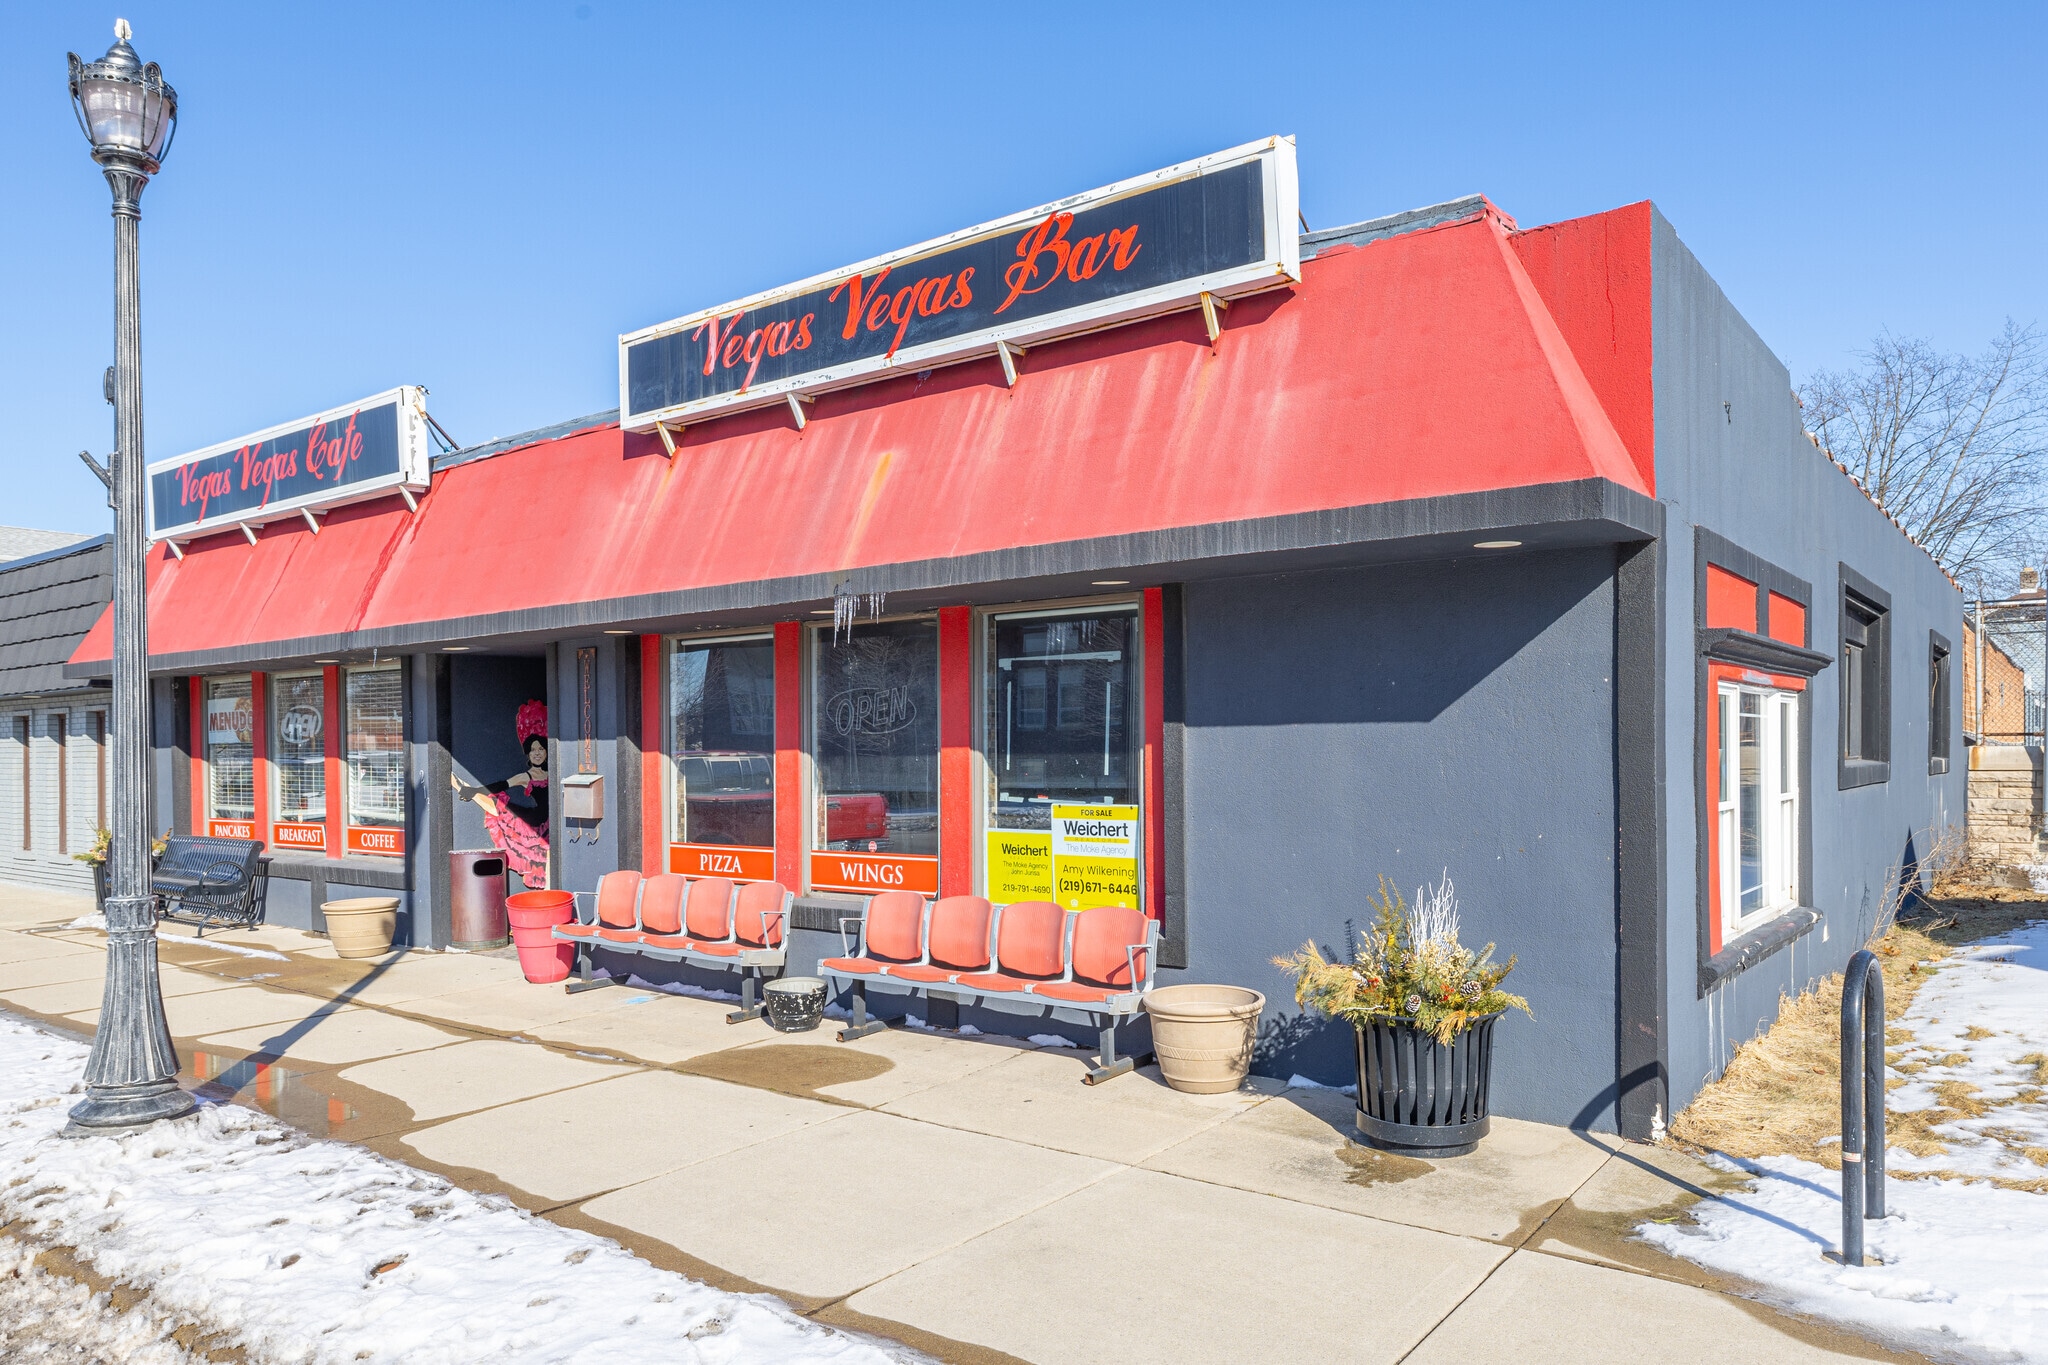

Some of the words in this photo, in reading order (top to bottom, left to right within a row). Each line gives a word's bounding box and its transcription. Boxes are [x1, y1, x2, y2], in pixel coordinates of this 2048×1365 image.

[692, 307, 814, 394] Vegas
[827, 265, 976, 359] Vegas
[993, 209, 1142, 315] Bar
[175, 461, 231, 525] Vegas
[234, 442, 298, 510] Vegas
[306, 408, 363, 481] Cafe
[835, 685, 908, 736] OPEN
[214, 825, 250, 838] PANCAKES
[279, 828, 321, 843] BREAKFAST
[1064, 820, 1129, 837] Weichert
[361, 833, 395, 848] COFFEE
[1001, 843, 1048, 857] Weichert
[1066, 844, 1079, 852] The
[1080, 845, 1100, 854] Moke
[1101, 846, 1128, 856] Agency
[700, 853, 743, 873] PIZZA
[1028, 863, 1048, 871] Agency
[840, 862, 904, 885] WINGS
[1063, 865, 1084, 877] Amy
[1086, 866, 1135, 881] Wilkening
[1059, 878, 1138, 896] (219)671-6446
